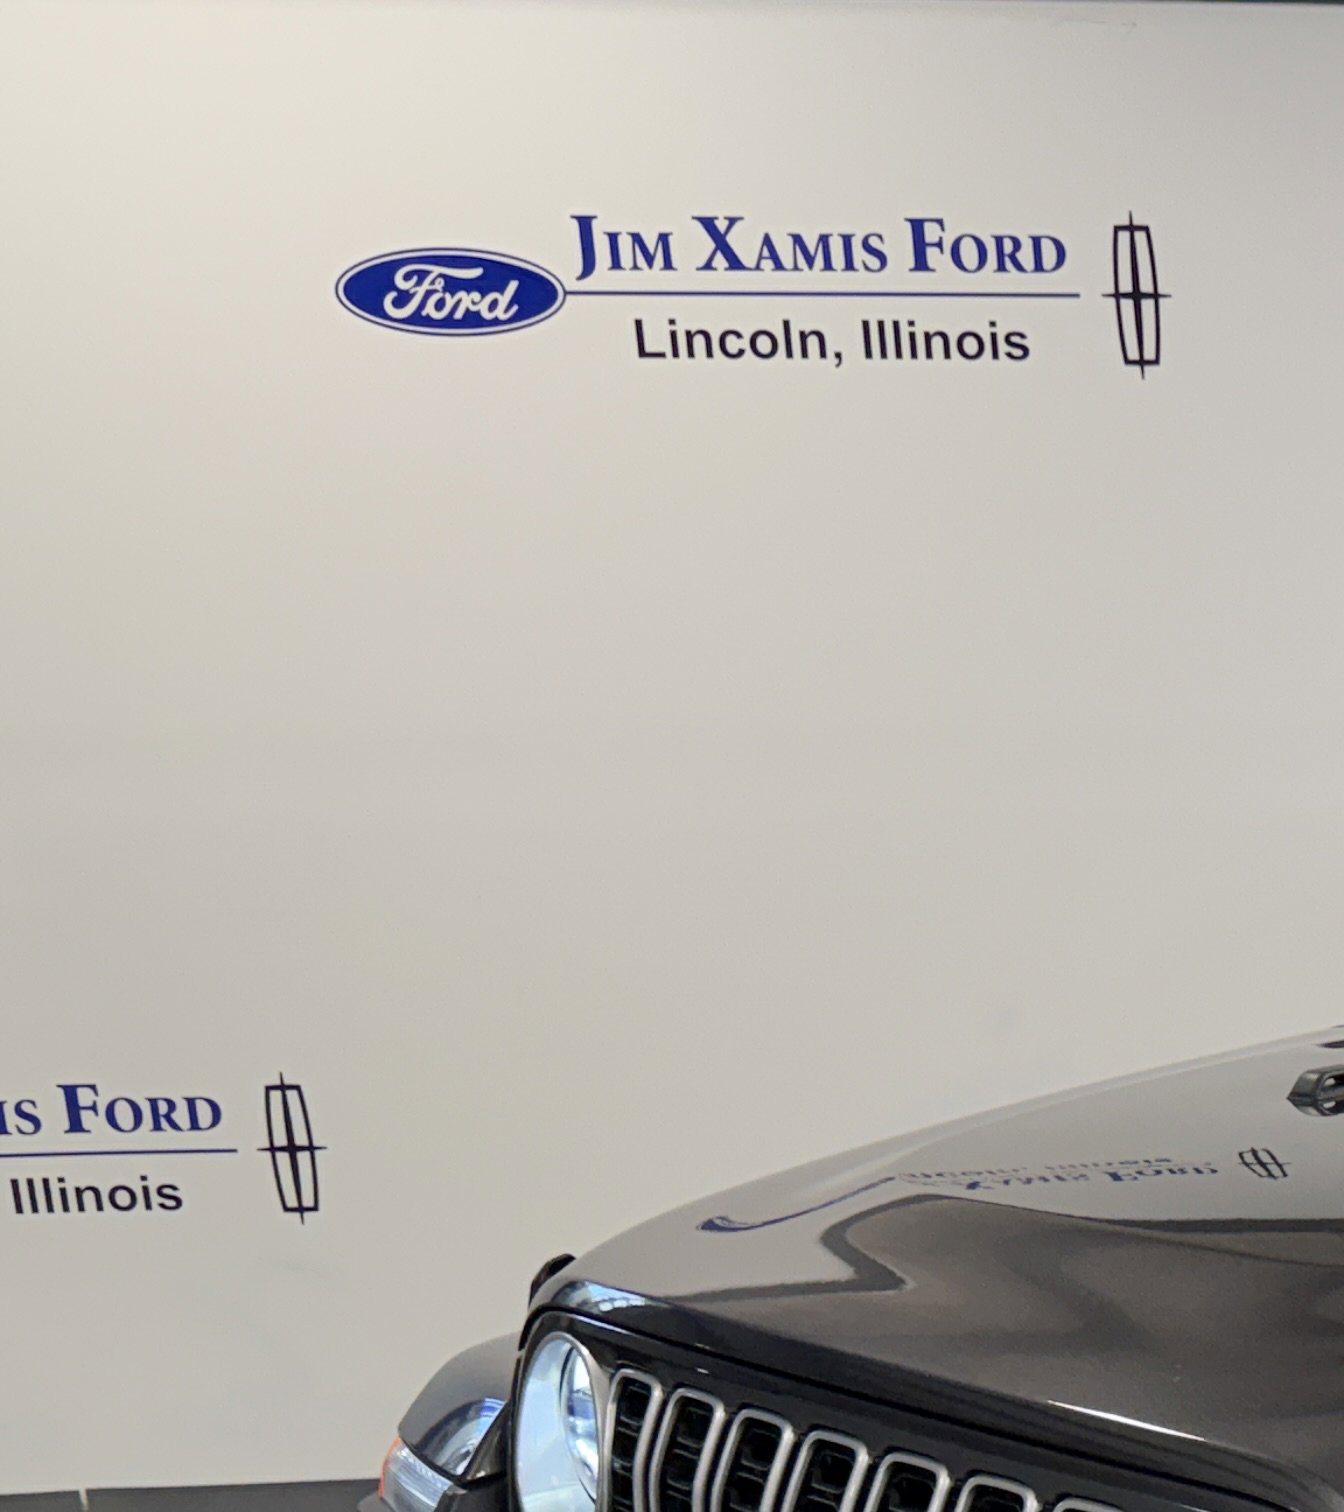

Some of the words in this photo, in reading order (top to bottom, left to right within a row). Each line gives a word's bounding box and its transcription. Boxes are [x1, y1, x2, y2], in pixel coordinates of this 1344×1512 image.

[570, 215, 676, 281] JIM
[691, 215, 889, 275] XAMIS
[904, 217, 1068, 275] FORD
[383, 263, 520, 321] Ford
[634, 318, 845, 368] Lincoln,
[861, 318, 1032, 361] Illinois
[55, 1083, 223, 1134] FORD
[9, 1174, 184, 1215] Illinois
